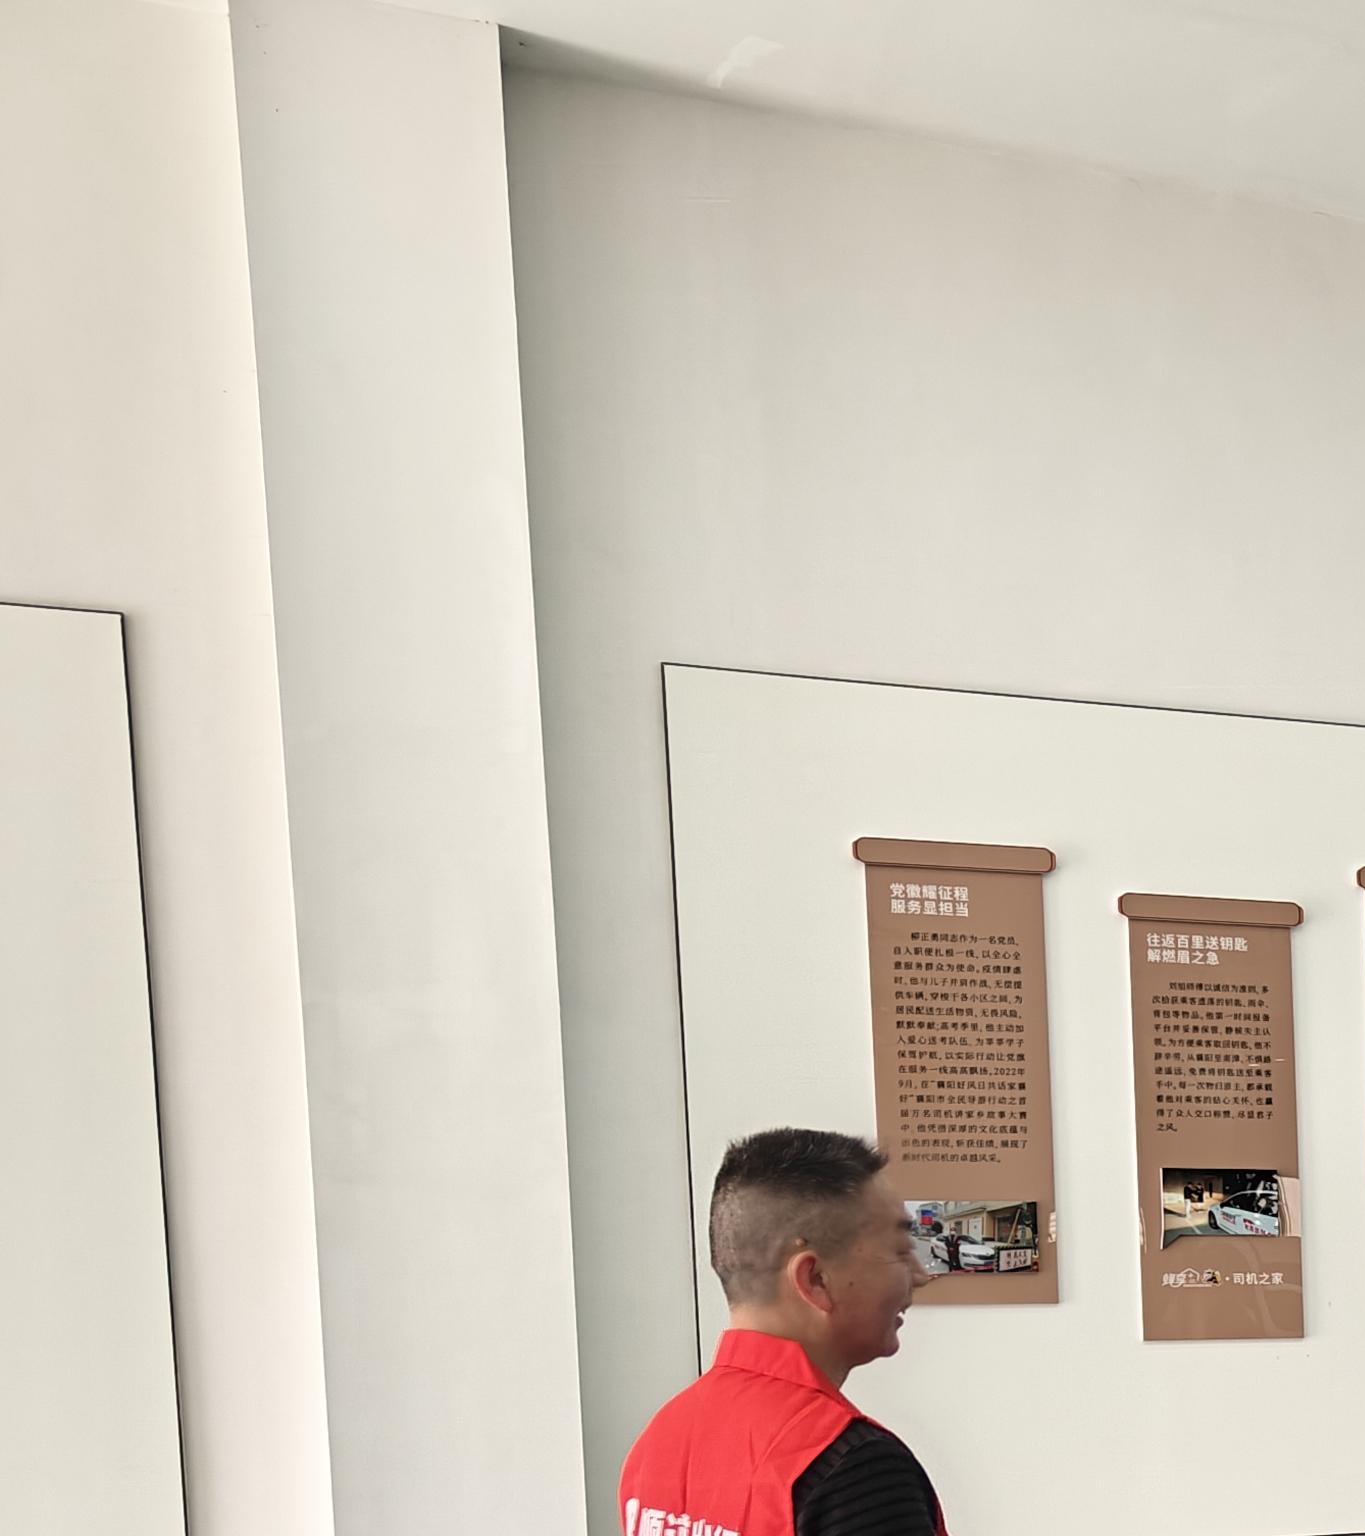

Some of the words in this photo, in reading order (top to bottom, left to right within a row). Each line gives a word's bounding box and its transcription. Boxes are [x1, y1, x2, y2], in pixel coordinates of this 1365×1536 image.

[889, 882, 969, 902] 党徽耀征程
[890, 898, 969, 917] 服务显担当
[1146, 932, 1249, 952] 往返百里送钥匙
[1147, 948, 1220, 966] 解燃眉之急
[1232, 1272, 1284, 1285] 司机之家
